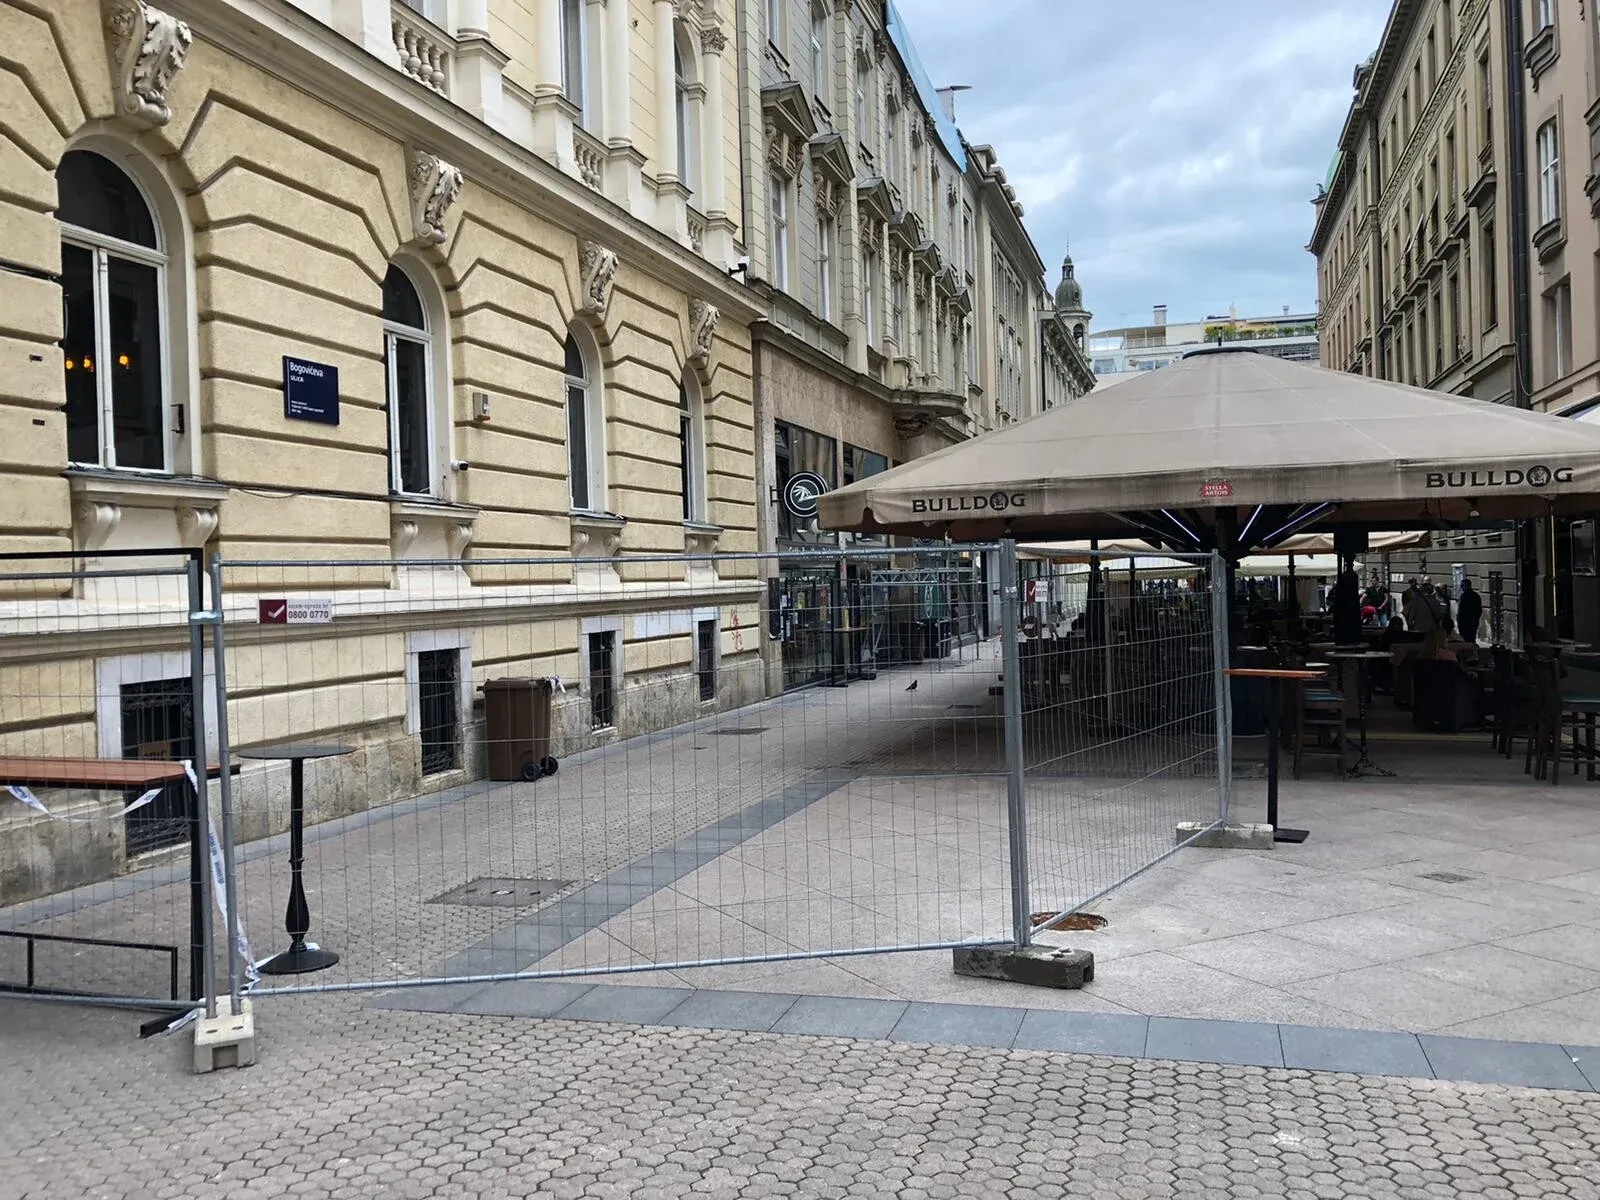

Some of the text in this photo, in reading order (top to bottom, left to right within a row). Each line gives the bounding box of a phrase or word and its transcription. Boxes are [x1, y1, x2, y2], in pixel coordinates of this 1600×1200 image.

[289, 361, 324, 377] Bogovićeva
[1425, 465, 1574, 488] BULLDOG
[912, 491, 1026, 513] BULLDOG
[288, 610, 329, 619] 0800 0770
